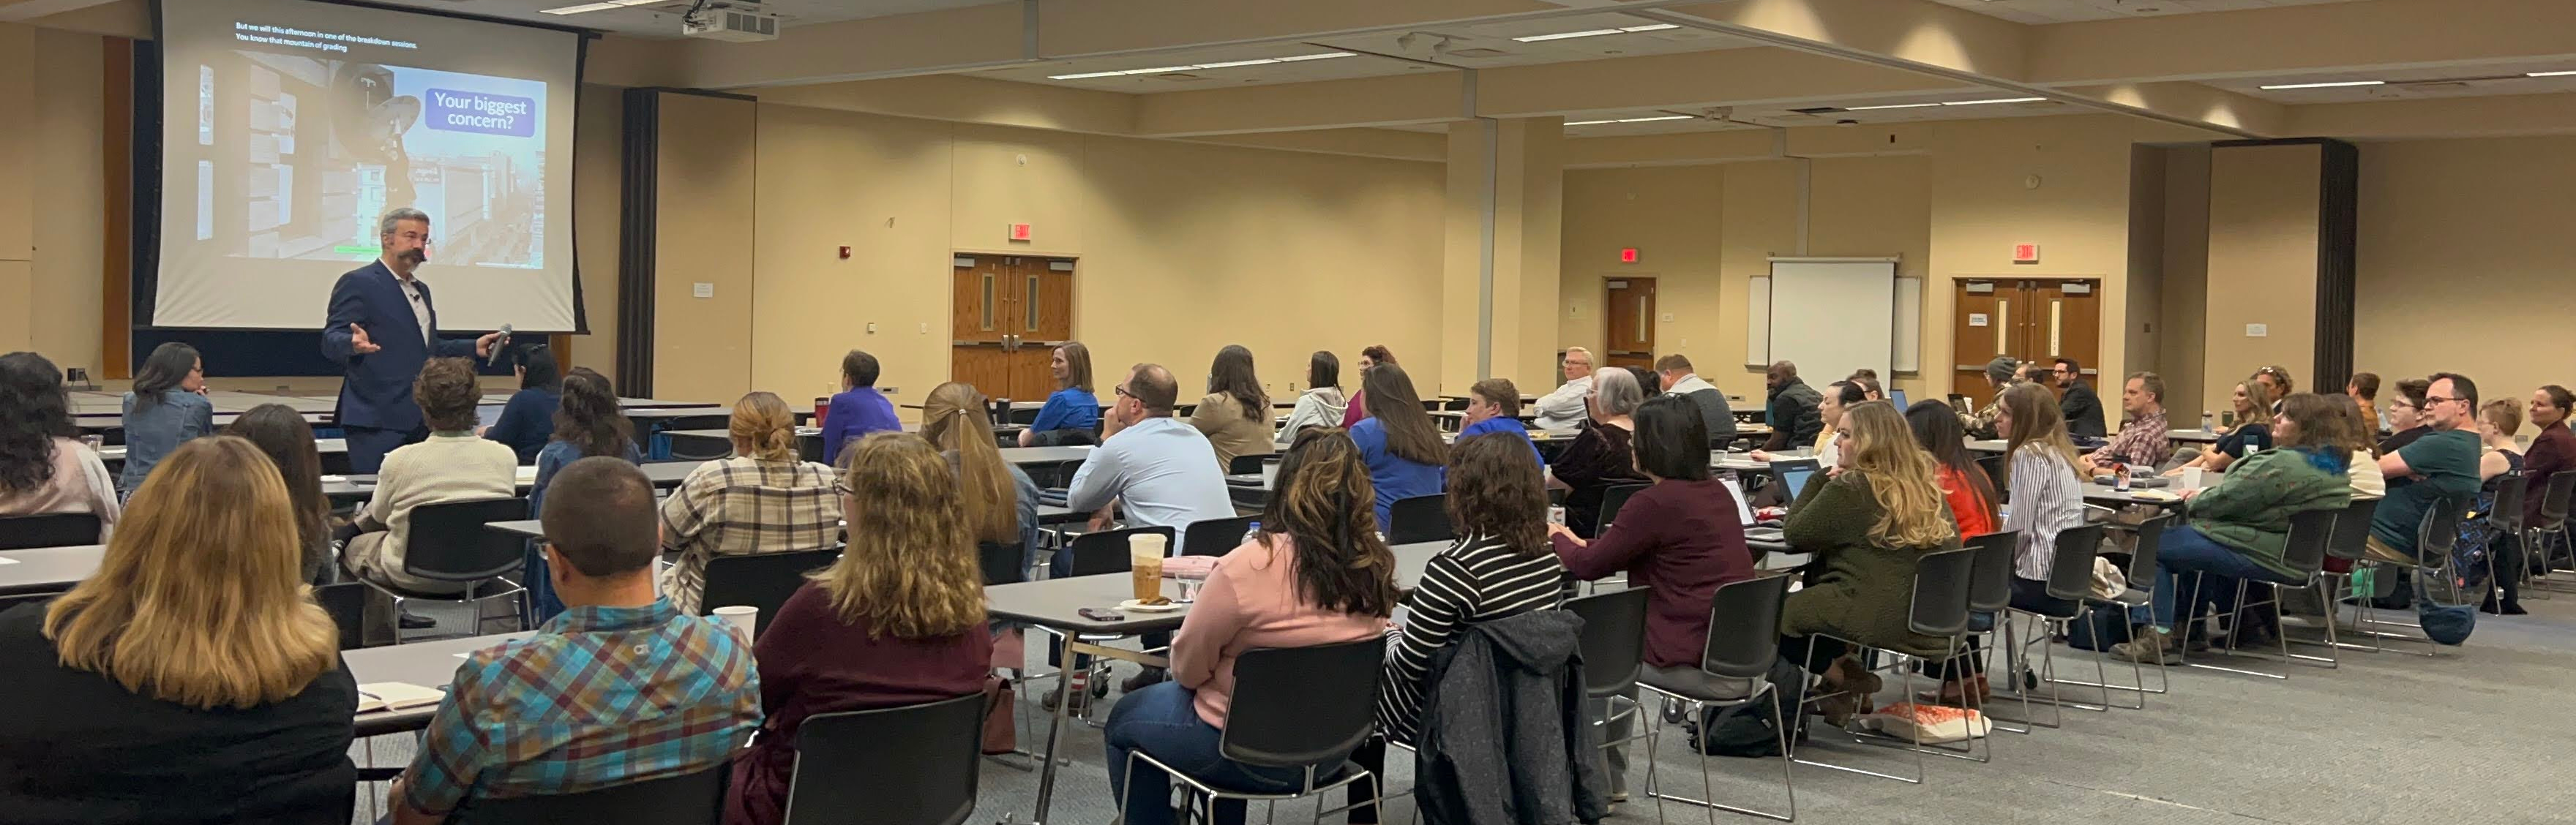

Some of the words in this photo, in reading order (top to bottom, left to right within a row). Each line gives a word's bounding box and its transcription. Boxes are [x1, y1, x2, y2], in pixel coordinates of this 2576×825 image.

[236, 22, 248, 30] But
[285, 28, 316, 37] afternoon
[357, 36, 391, 45] breakdown
[236, 33, 249, 41] You
[250, 34, 269, 42] know
[269, 37, 282, 45] that
[284, 39, 315, 48] mountain
[323, 44, 348, 53] grading
[435, 91, 471, 109] Your
[475, 96, 526, 116] biggest
[447, 113, 514, 129] concern?
